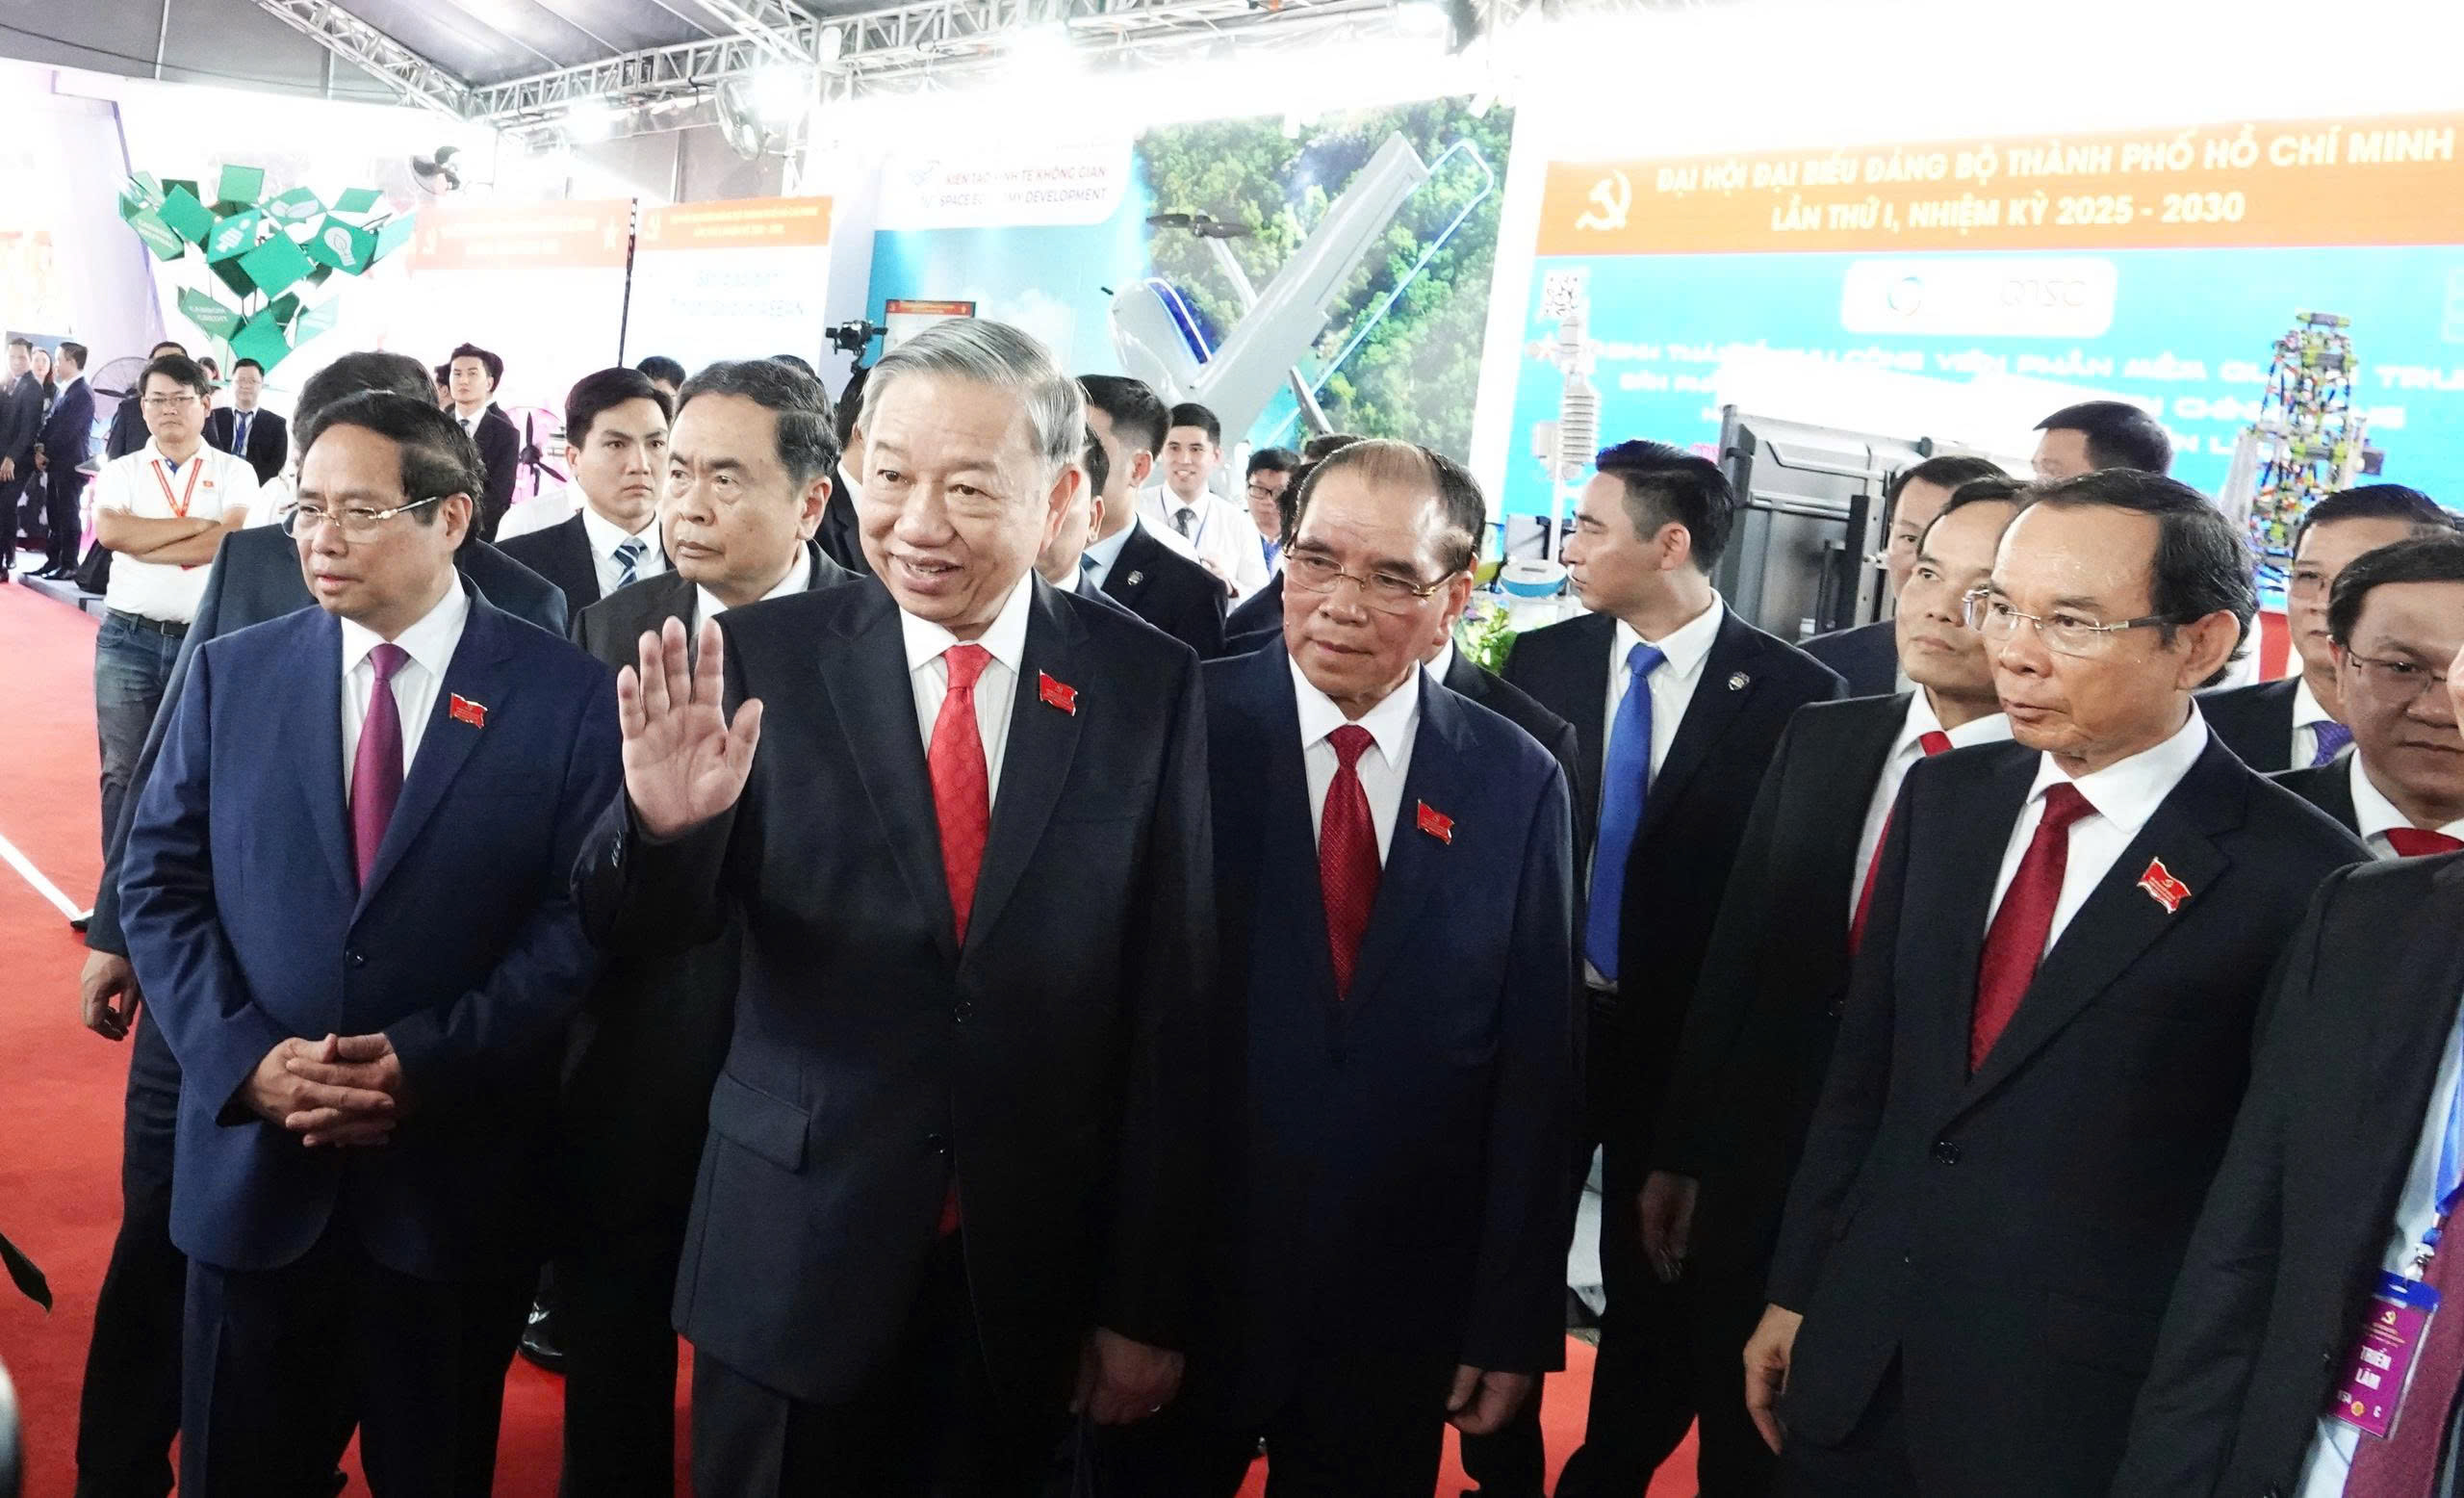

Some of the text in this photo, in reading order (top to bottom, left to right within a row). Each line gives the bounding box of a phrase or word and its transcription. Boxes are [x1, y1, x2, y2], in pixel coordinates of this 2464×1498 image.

[1656, 167, 1698, 195] ĐẠI
[1703, 158, 1748, 194] HỘI
[1753, 160, 1798, 193] ĐẠI
[1865, 145, 1947, 182] ĐẢNG
[1956, 142, 1998, 185] BỘ
[2007, 140, 2112, 175] THÀNH
[2121, 129, 2200, 171] PHỐ
[2204, 123, 2258, 168] HỒ
[2270, 125, 2341, 167] CHÍ
[2348, 127, 2453, 162] MINH
[1025, 187, 1107, 203] DEVELOPMENT
[1771, 194, 1821, 231] LẦN
[1827, 196, 1879, 229] THỨ
[1909, 194, 1999, 234] NHIỆM
[2008, 191, 2048, 225] KỲ
[2056, 195, 2134, 224] 2025
[2162, 192, 2245, 222] 2030
